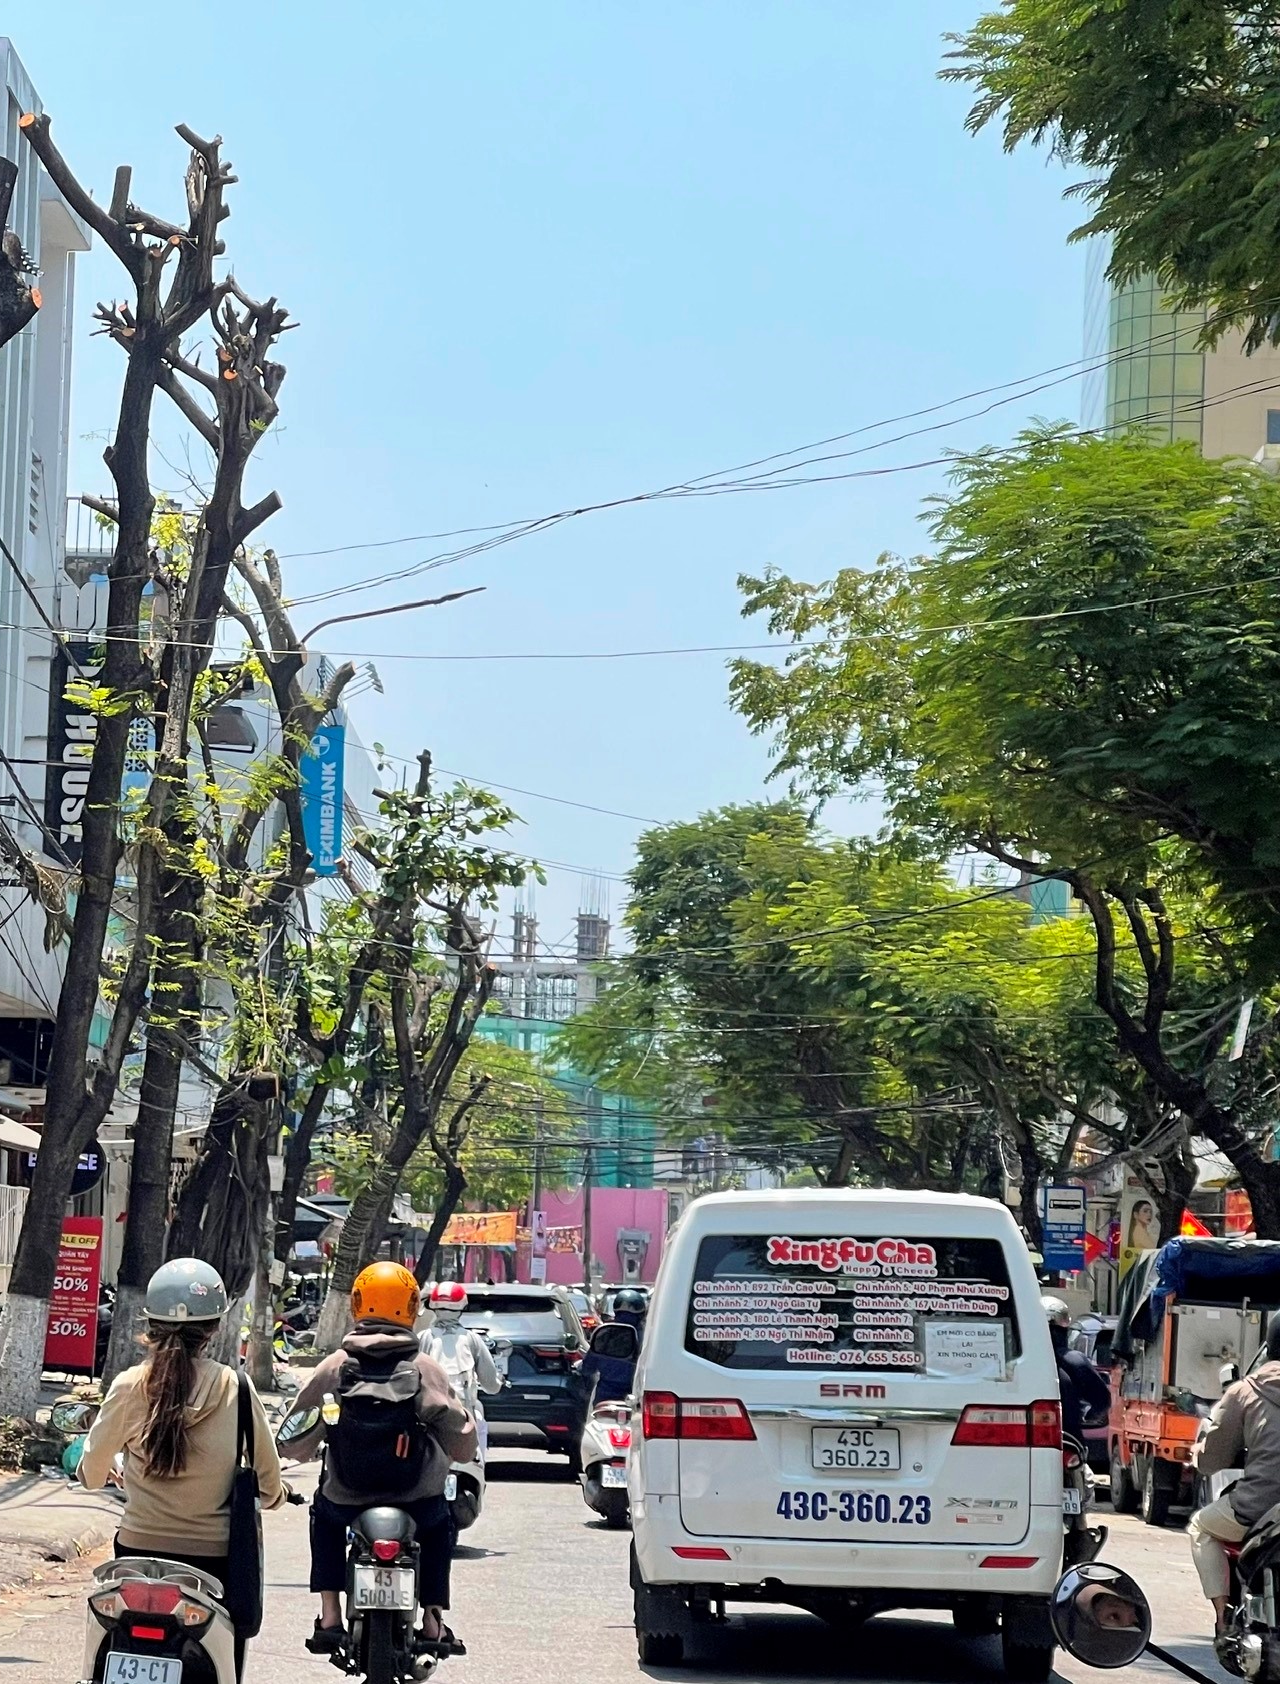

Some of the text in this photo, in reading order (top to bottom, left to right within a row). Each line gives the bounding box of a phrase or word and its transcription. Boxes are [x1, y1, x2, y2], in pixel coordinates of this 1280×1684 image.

[320, 761, 337, 867] EXIMBANK
[78, 1236, 97, 1245] OFF
[845, 1264, 879, 1276] Happy
[896, 1266, 936, 1275] Cheese
[53, 1276, 89, 1292] 50%
[695, 1283, 711, 1292] Chi
[752, 1283, 769, 1292] 892
[795, 1283, 813, 1292] Cao
[855, 1282, 871, 1292] Chi
[903, 1283, 911, 1292] 5:
[913, 1284, 926, 1292] 40
[695, 1299, 711, 1308] Chi
[753, 1300, 768, 1308] 107
[791, 1299, 806, 1308] Gia
[855, 1299, 871, 1308] Chi
[914, 1300, 929, 1308] 167
[695, 1315, 711, 1324] Chi
[754, 1315, 770, 1323] 180
[784, 1315, 813, 1323] Thanh
[855, 1315, 871, 1323] Chi
[904, 1316, 912, 1324] 7:
[48, 1321, 87, 1337] 30%
[695, 1330, 711, 1339] Chi
[743, 1331, 752, 1339] 4:
[754, 1331, 766, 1339] 30
[855, 1331, 871, 1340] Chi
[789, 1350, 921, 1364] Hotline: 076 655 5650
[820, 1384, 886, 1398] SRM
[837, 1430, 874, 1447] 43C
[822, 1449, 890, 1467] 360.23
[776, 1490, 933, 1526] 43C-360.23
[375, 1569, 393, 1588] 43
[117, 1657, 169, 1683] 43-C1
